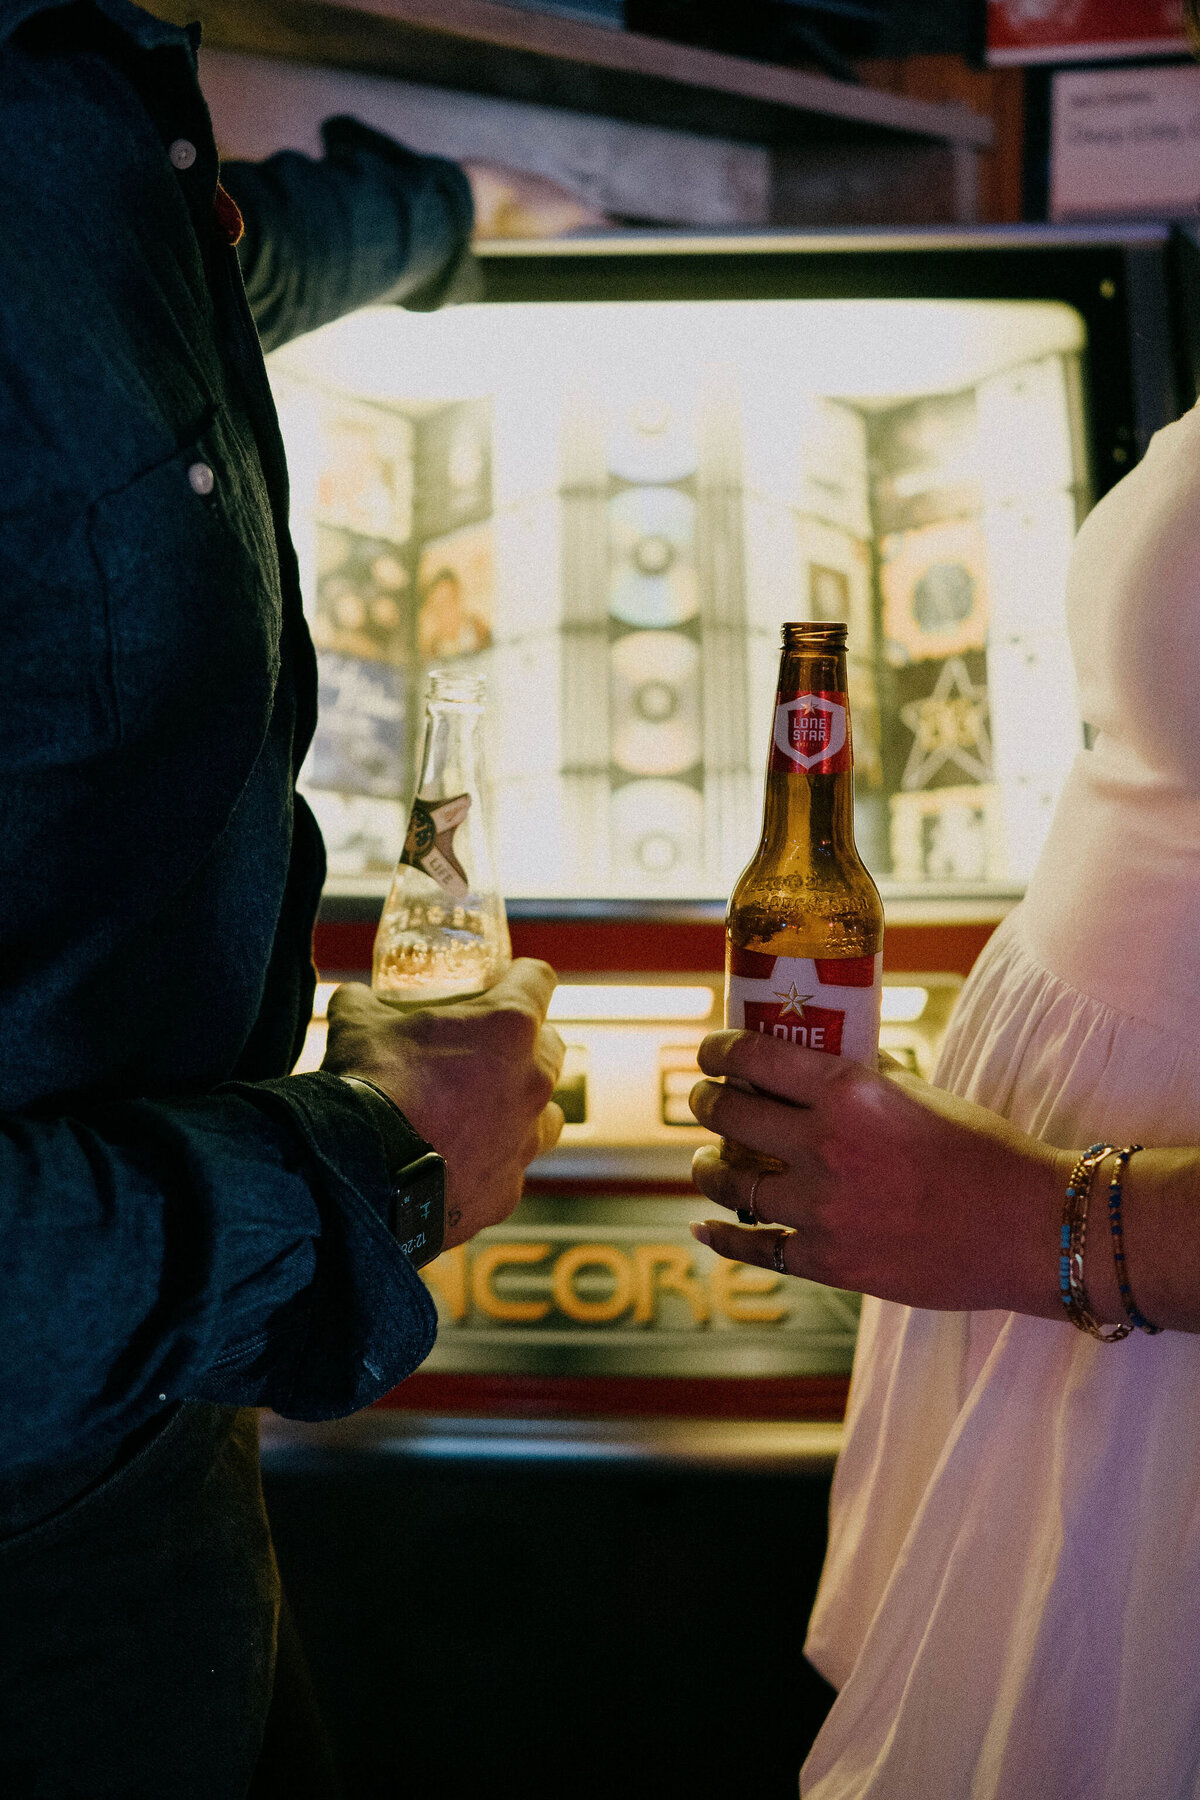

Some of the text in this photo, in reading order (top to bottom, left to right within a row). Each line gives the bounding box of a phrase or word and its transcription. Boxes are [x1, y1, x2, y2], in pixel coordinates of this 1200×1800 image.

[793, 717, 827, 729] LONE
[792, 729, 827, 741] STAR
[430, 858, 453, 884] LIFE
[401, 1232, 426, 1255] 12:28
